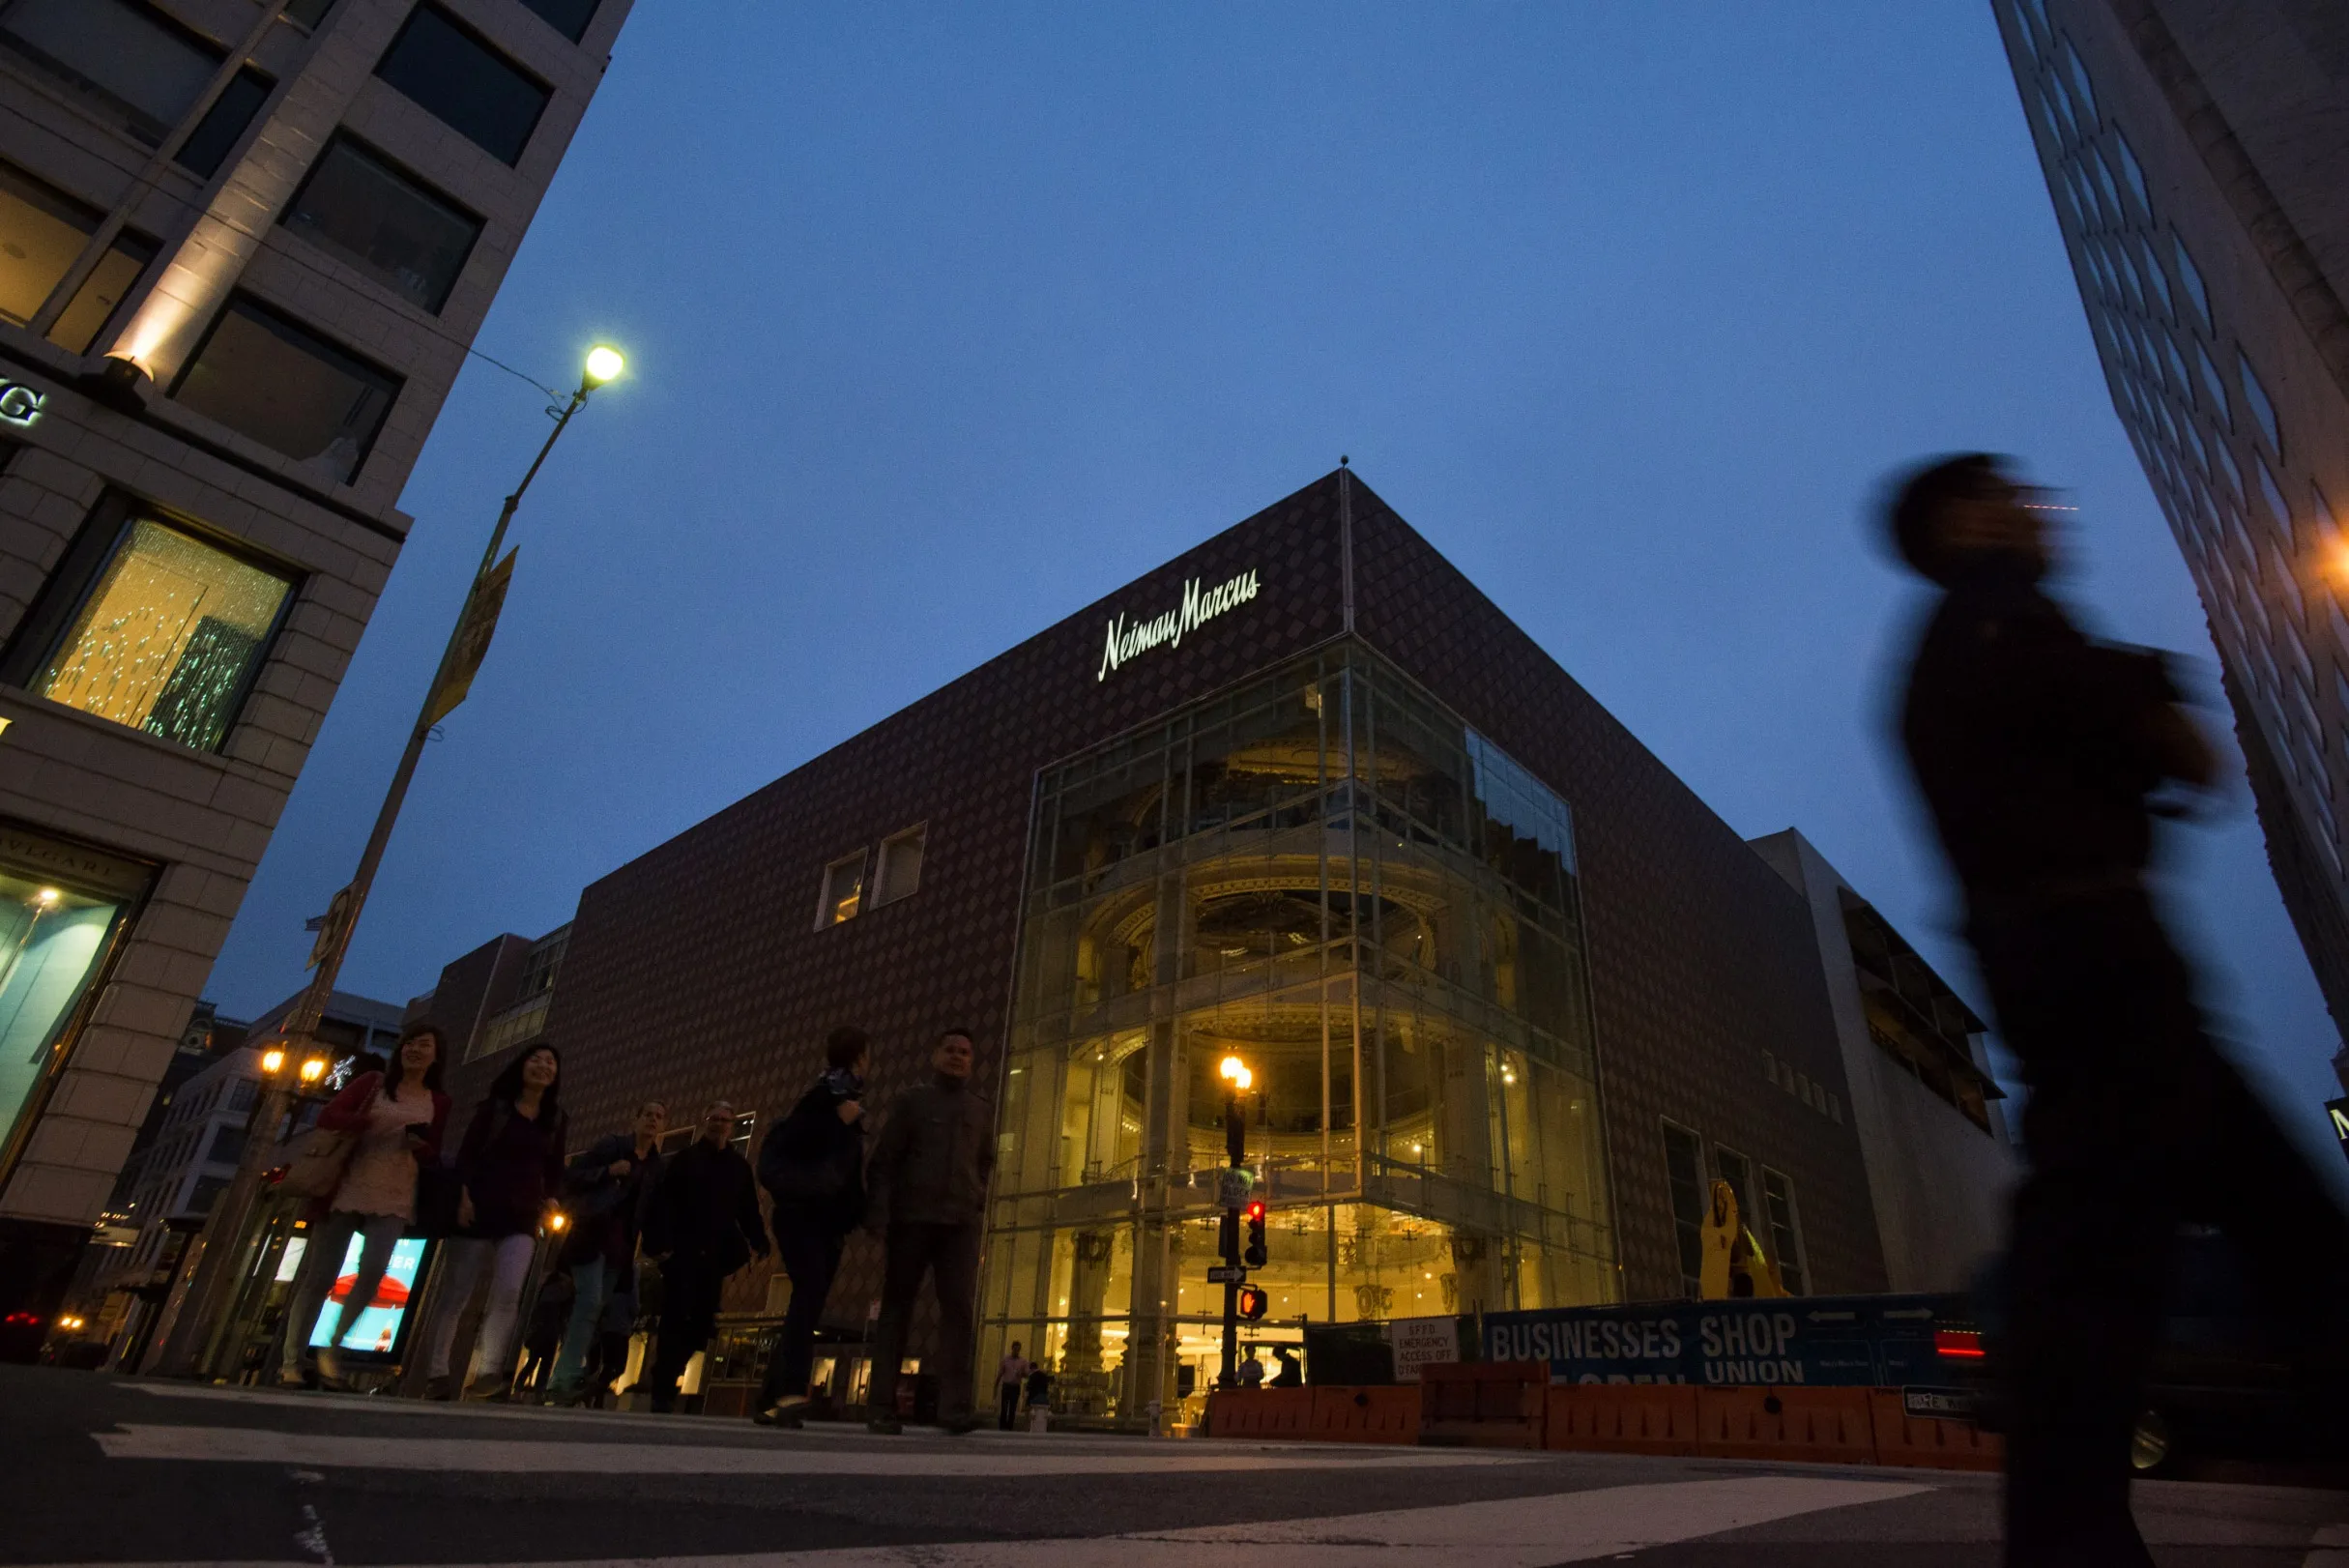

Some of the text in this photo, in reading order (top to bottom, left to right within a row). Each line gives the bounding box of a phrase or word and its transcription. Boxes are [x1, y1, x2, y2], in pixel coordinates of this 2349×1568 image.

[0, 378, 46, 426] G
[1098, 567, 1261, 682] Neiman Marcus
[0, 839, 110, 877] VLGARI
[1399, 1336, 1449, 1349] EMERGENCY
[1492, 1319, 1682, 1362] BUSINESSES
[1700, 1313, 1797, 1357] SHOP
[1400, 1350, 1452, 1362] ACCESS OFF
[1704, 1359, 1805, 1384] UNION
